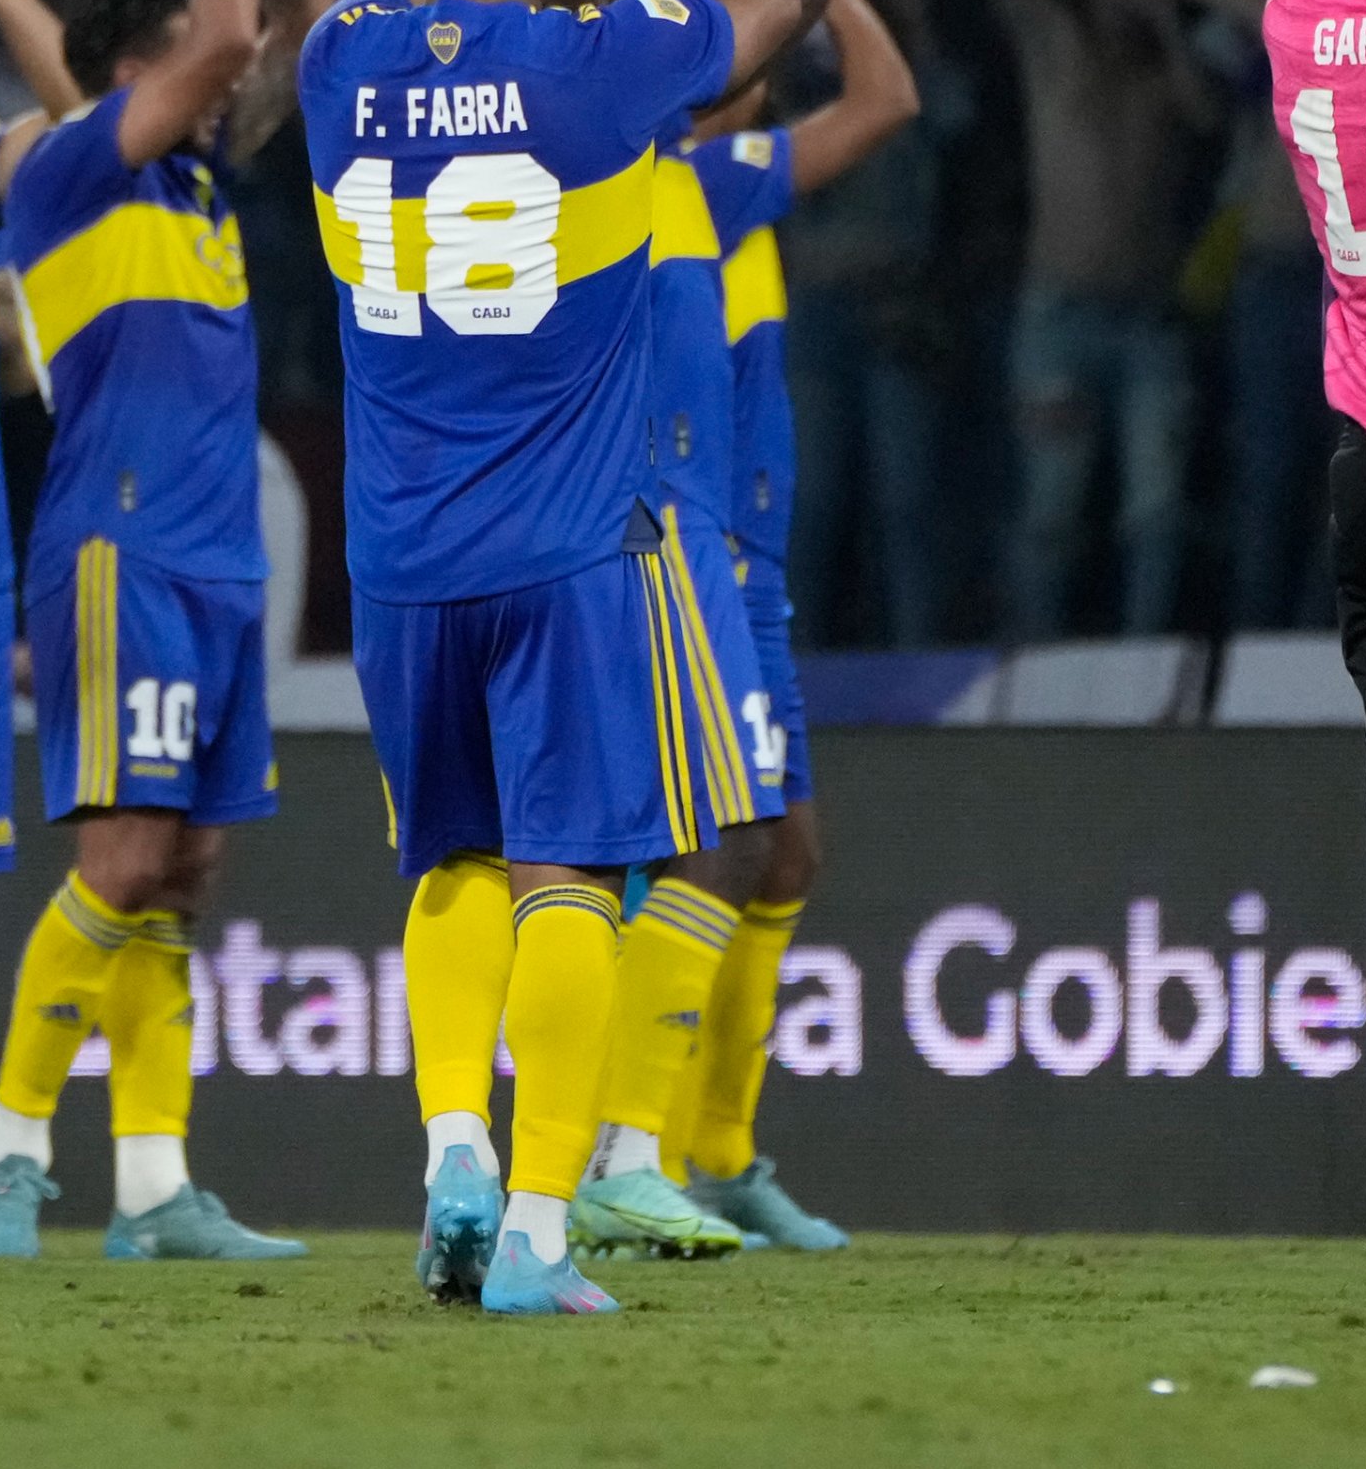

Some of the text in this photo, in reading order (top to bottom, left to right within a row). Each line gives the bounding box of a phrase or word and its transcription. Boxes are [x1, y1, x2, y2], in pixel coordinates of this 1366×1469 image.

[356, 81, 529, 138] F. FABRA
[332, 152, 561, 337] 18
[367, 306, 398, 321] CABJ
[472, 307, 511, 320] CABJ
[125, 677, 197, 762] 10
